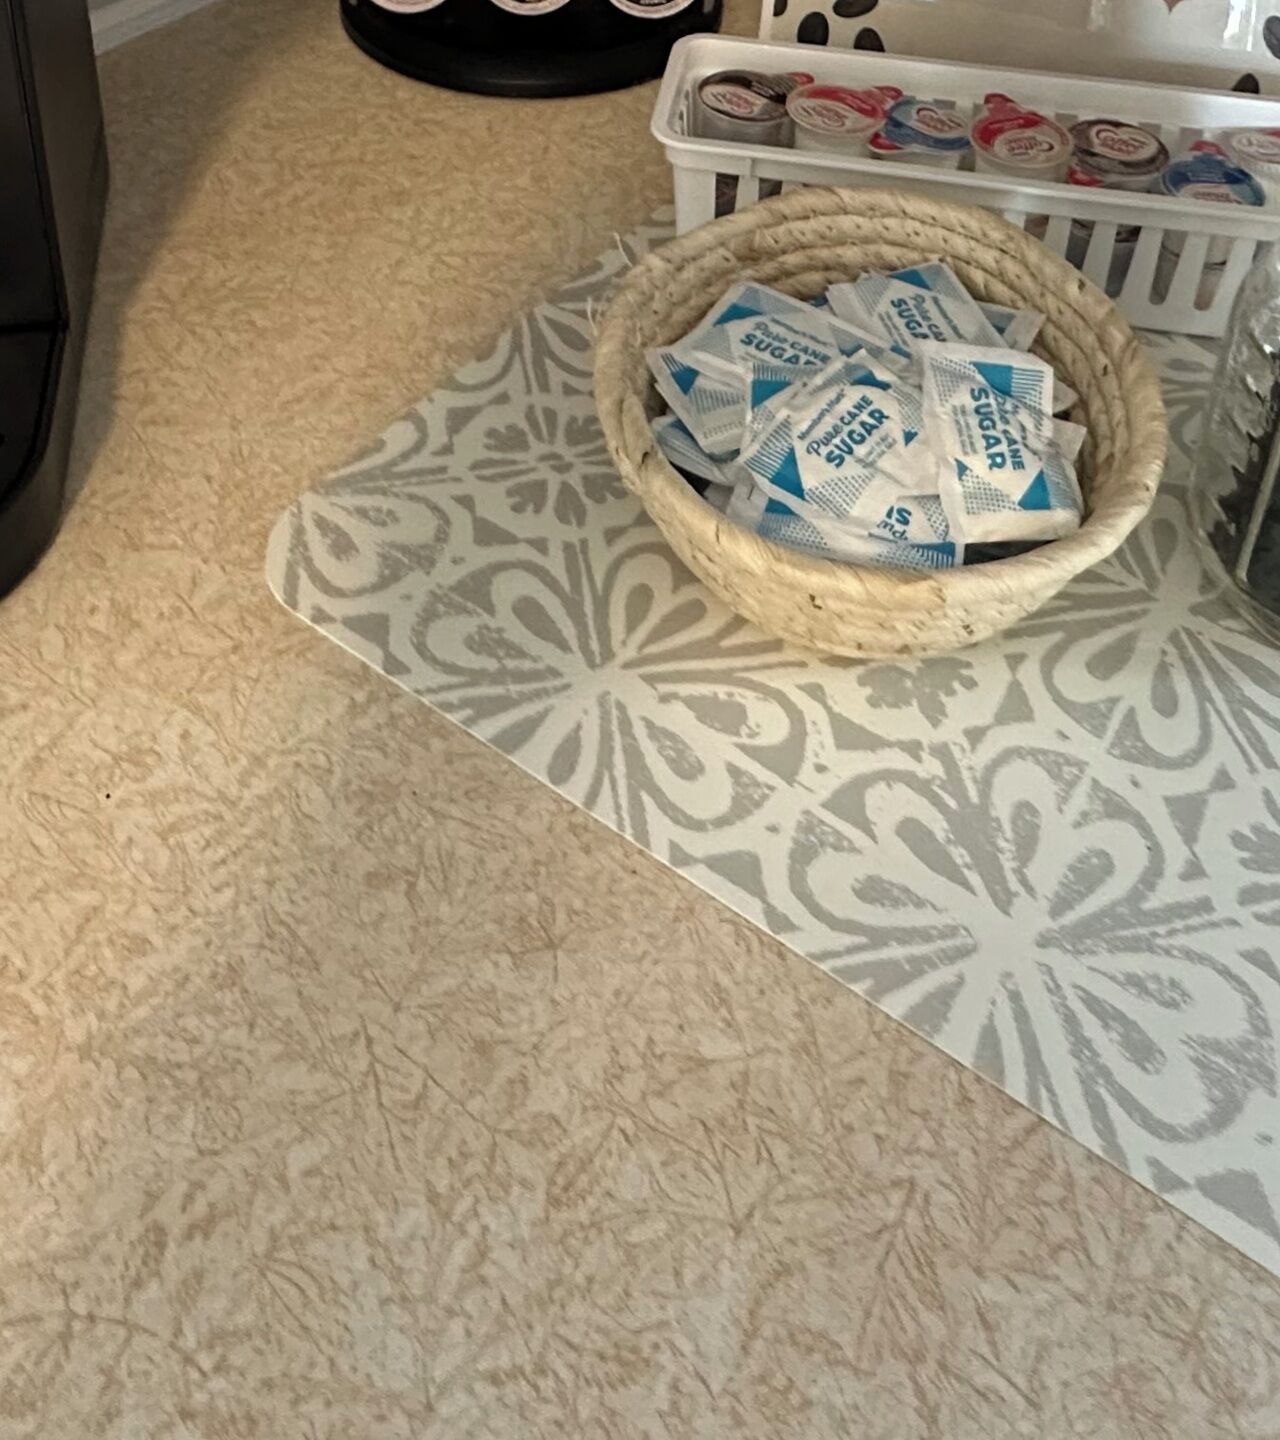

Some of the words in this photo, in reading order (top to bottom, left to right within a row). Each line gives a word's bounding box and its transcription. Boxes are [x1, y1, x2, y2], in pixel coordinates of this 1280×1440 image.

[806, 423, 844, 457] Pure
[840, 394, 874, 426] CANE
[825, 408, 890, 469] SUGAR
[970, 387, 1007, 471] SUGAR
[1002, 428, 1026, 471] CANE
